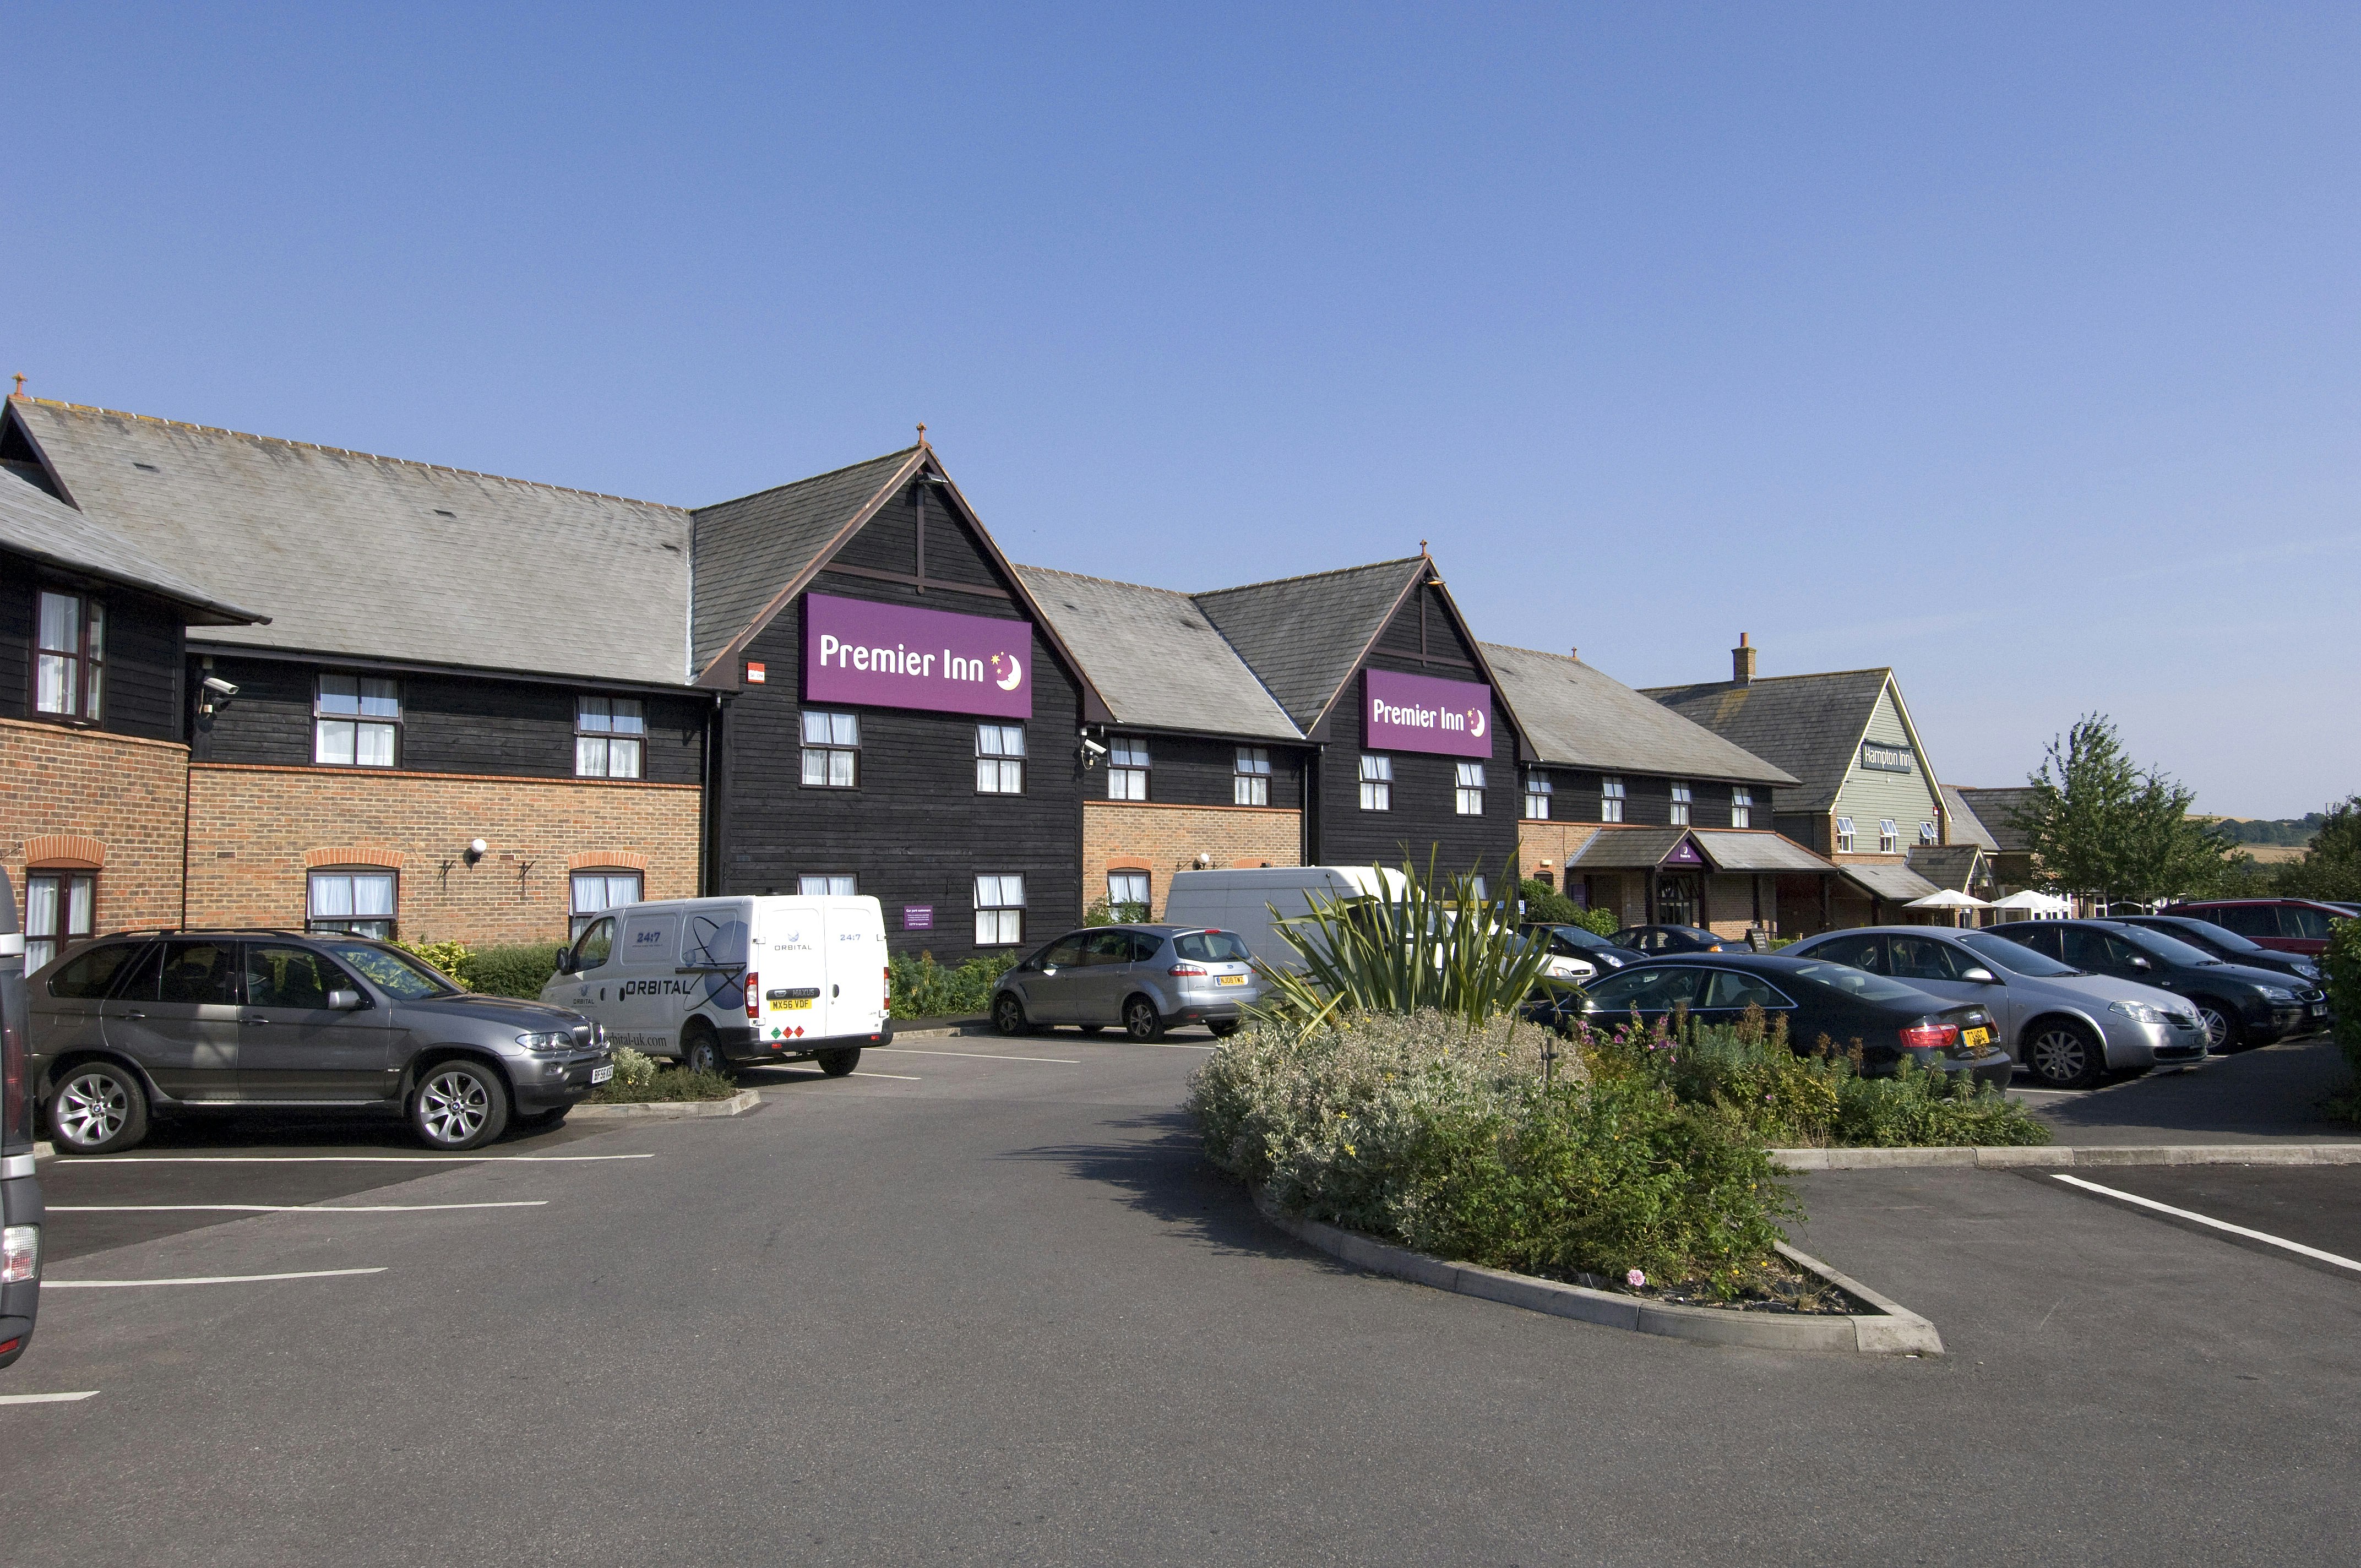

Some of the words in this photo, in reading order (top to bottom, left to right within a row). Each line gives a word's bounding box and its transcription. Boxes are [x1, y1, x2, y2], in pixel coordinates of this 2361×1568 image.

[820, 634, 935, 677] Premier
[944, 649, 983, 682] Inn
[1374, 699, 1437, 728] Premier
[1440, 706, 1464, 731] Inn
[1865, 746, 1898, 769] Hampton
[1899, 750, 1910, 767] Inn
[637, 932, 661, 943] 24:7
[625, 980, 691, 995] ORBITAL
[773, 1000, 793, 1009] MX56
[795, 999, 809, 1008] VDF
[603, 1032, 667, 1047] orbital-uk.com
